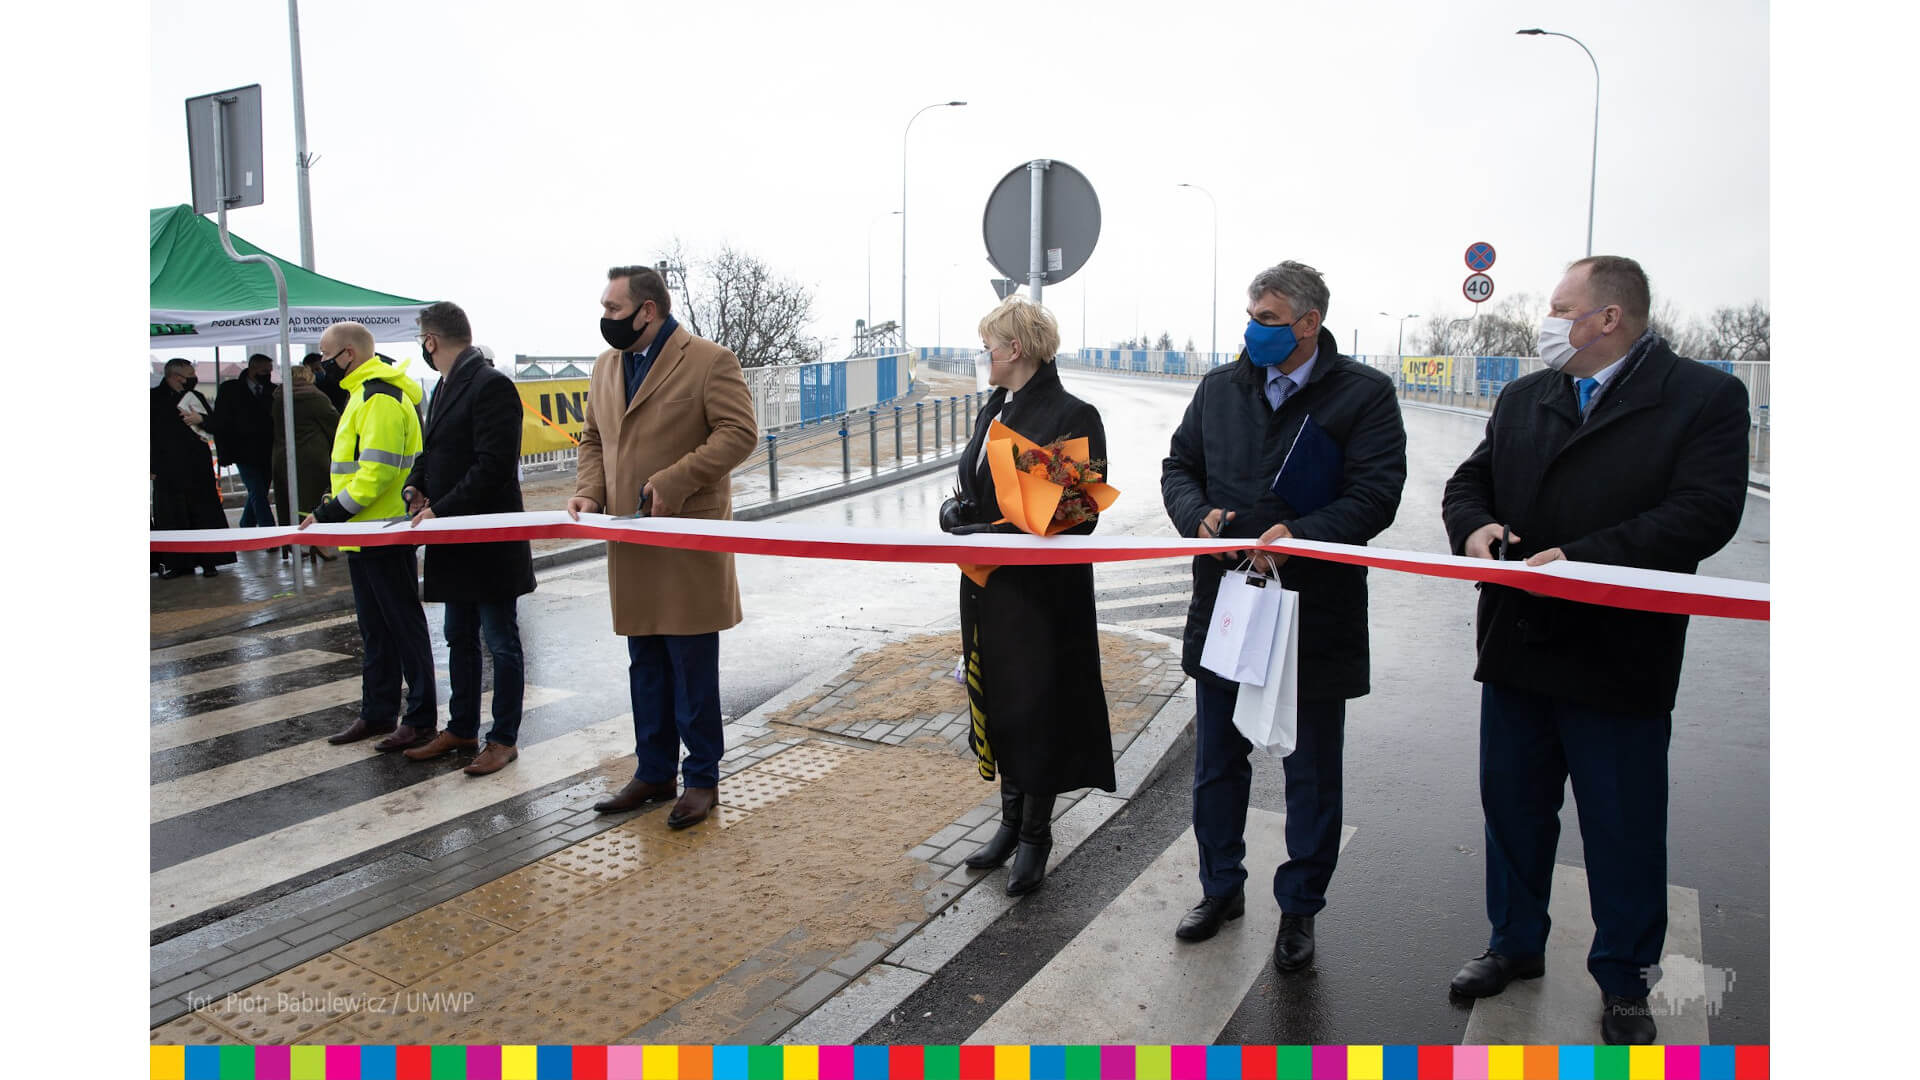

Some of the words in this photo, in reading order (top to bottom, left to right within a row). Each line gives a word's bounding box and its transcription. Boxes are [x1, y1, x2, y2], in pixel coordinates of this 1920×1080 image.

[1467, 280, 1490, 296] 40
[211, 318, 261, 327] PODLASKI
[264, 317, 302, 326] ZARĄD
[303, 316, 330, 325] DRÓG
